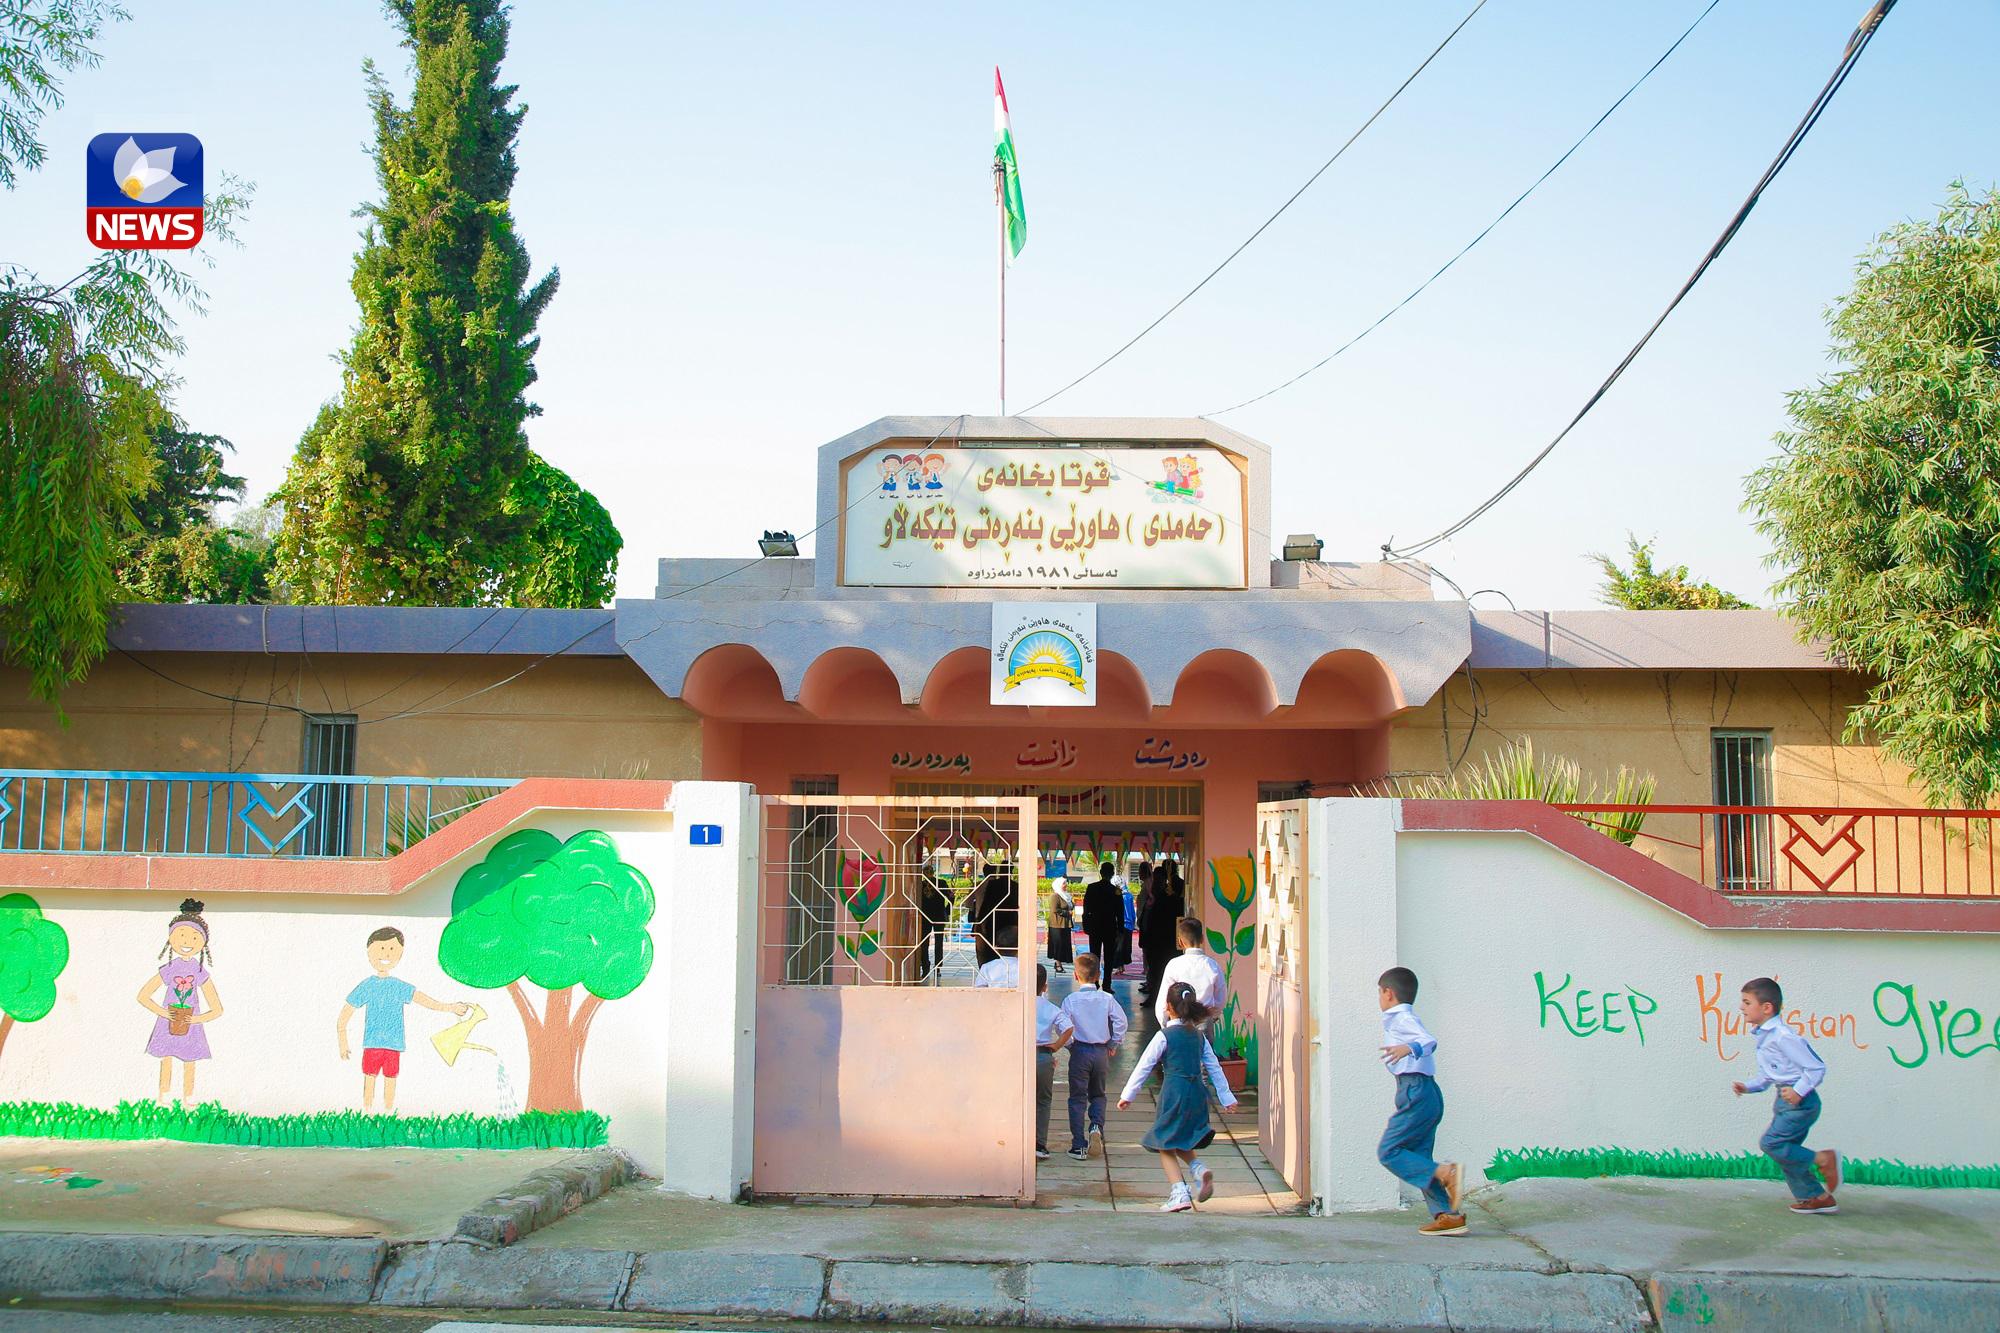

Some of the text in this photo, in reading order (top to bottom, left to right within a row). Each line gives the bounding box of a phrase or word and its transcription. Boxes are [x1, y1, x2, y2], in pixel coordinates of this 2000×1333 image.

[1027, 565, 1070, 578] ١٩٨١
[1016, 739, 1078, 771] زانست
[702, 825, 709, 844] 1
[1873, 981, 2000, 1069] gre
